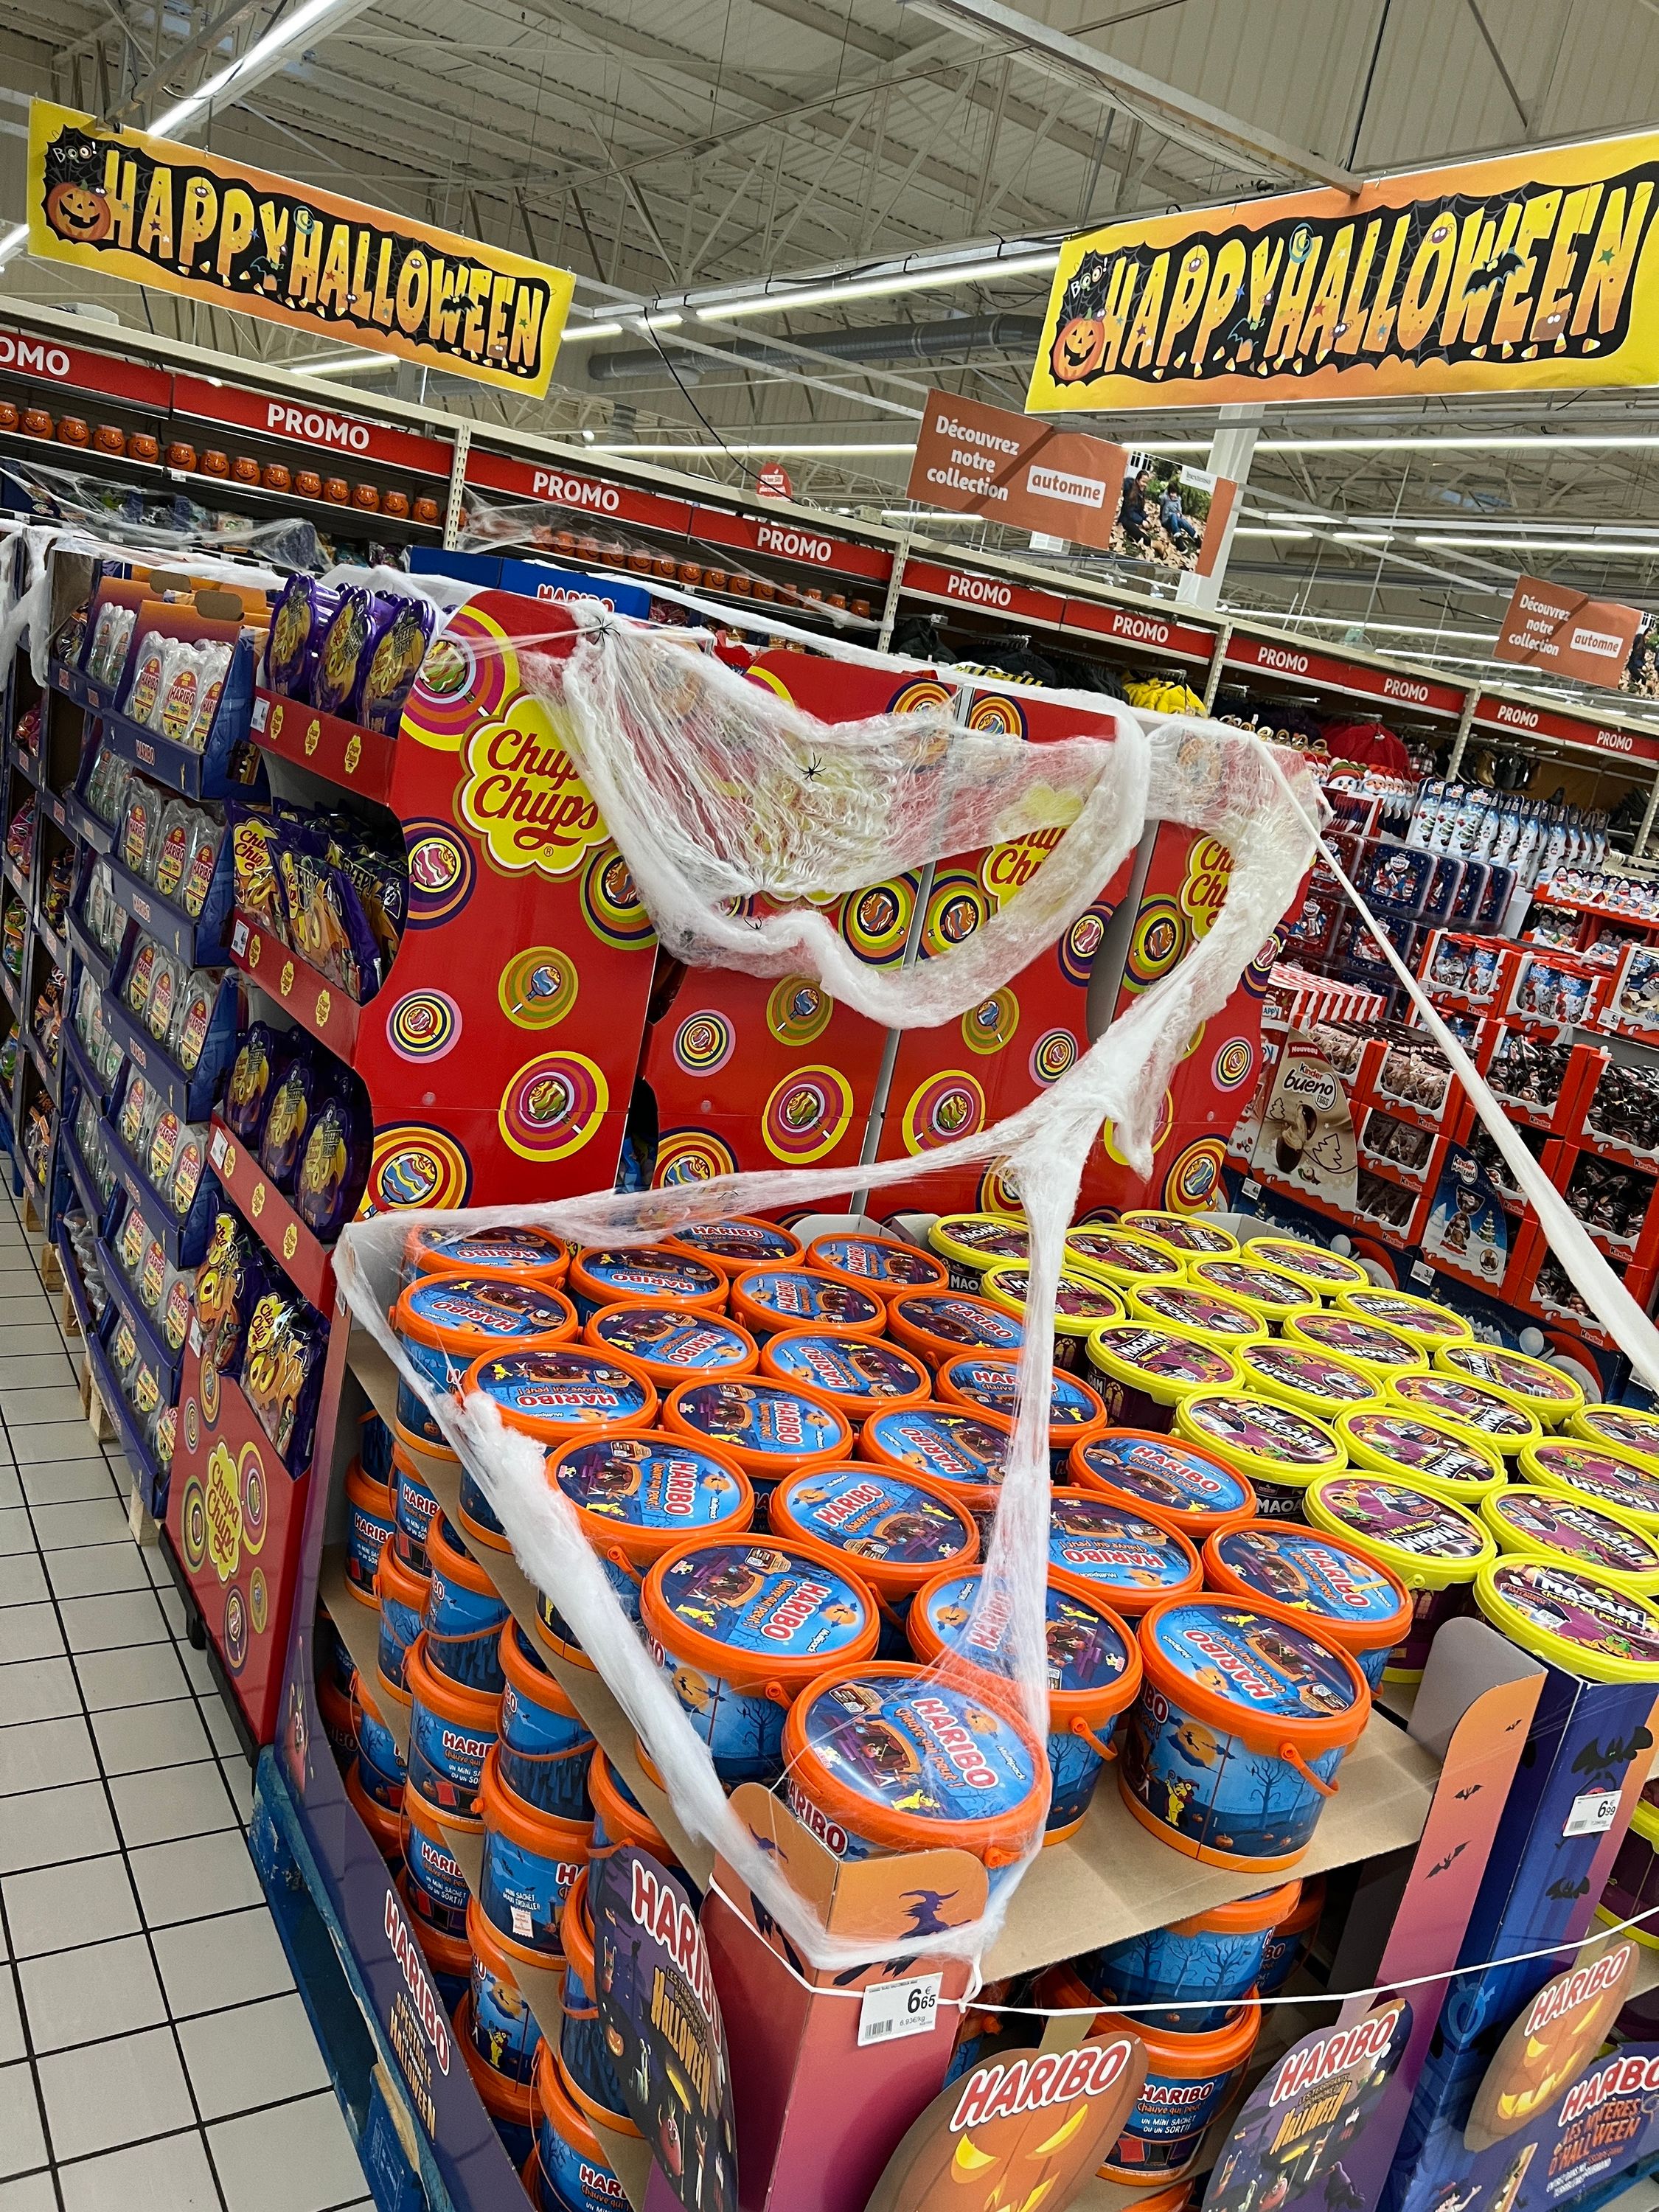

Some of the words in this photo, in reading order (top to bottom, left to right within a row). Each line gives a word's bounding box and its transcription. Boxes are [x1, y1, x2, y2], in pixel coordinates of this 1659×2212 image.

[54, 141, 99, 164] BOO!
[105, 149, 289, 291] HAPPY
[288, 207, 543, 367] HALLOWEEN
[1070, 257, 1109, 299] BOO!
[1098, 234, 1284, 374] HAPPY
[1264, 181, 1656, 361] HALLOWEEN
[0, 337, 70, 376] OMO
[267, 403, 369, 450] PROMO
[936, 415, 1020, 456] Découvrez
[950, 448, 995, 474] notre
[532, 472, 619, 512] PROMO
[927, 467, 1009, 501] collection
[1032, 473, 1102, 501] automne
[757, 528, 832, 563] PROMO
[947, 574, 1012, 607] PROMO
[1520, 594, 1571, 622] Découvrez
[1113, 614, 1169, 644] PROMO
[1526, 618, 1554, 635] notre
[1509, 632, 1559, 656] collection
[1575, 633, 1619, 653] automne
[1257, 646, 1309, 673] PROMO
[169, 686, 195, 706] HARIBO
[1384, 678, 1428, 703] PROMO
[1497, 704, 1539, 728] PROMO
[136, 740, 155, 765] HARIBO
[1596, 730, 1633, 751] PROMO
[473, 773, 599, 849] Chups
[165, 841, 185, 861] HARIBO
[195, 860, 213, 882] HARIBO
[1467, 1004, 1489, 1018] Kinder
[1291, 1046, 1318, 1055] Nouveau
[1284, 1068, 1334, 1096] bueno
[1300, 1062, 1324, 1080] Kinder
[1317, 1094, 1330, 1107] EGGS
[1418, 1117, 1439, 1132] Kinder
[1529, 1114, 1551, 1130] Kinder
[181, 1156, 199, 1180] HARIBO
[1400, 1177, 1422, 1192] Kinder
[692, 1226, 764, 1239] HARIBO
[955, 1222, 1007, 1243] MAOAM
[1382, 1232, 1404, 1248] Kinder
[457, 1248, 541, 1260] HARIBO
[847, 1245, 868, 1275] HARIBO
[1121, 1243, 1166, 1272] MAOAM
[1610, 1246, 1632, 1262] Kinder
[611, 1273, 695, 1292] HARIBO
[776, 1280, 799, 1312] HARIBO
[950, 1275, 980, 1291] MAO
[1253, 1273, 1303, 1301] MAOAM
[432, 1300, 519, 1332] HARIBO
[1365, 1299, 1412, 1313] MAOAM
[946, 1303, 1014, 1340] HARIBO
[667, 1331, 726, 1364] HARIBO
[1117, 1331, 1169, 1359] MAOAM
[1580, 1329, 1604, 1346] Kinder
[799, 1346, 850, 1388] HARIBO
[1254, 1362, 1332, 1397] MAOAM
[517, 1393, 619, 1407] HARIBO
[774, 1399, 803, 1444] HARIBO
[1249, 1408, 1323, 1450] MAOAM
[901, 1427, 967, 1473] HARIBO
[1132, 1446, 1222, 1493] HARIBO
[212, 1461, 240, 1528] Chupa
[403, 1484, 440, 1517] HARIB
[664, 1461, 698, 1516] HARIBO
[1572, 1476, 1656, 1511] MAOAM
[813, 1483, 886, 1528] HARIBO
[1256, 1498, 1304, 1513] MAOA
[207, 1489, 236, 1564] Chups
[1391, 1524, 1464, 1553] MAOAM
[1559, 1511, 1643, 1557] MAOAM
[1063, 1548, 1167, 1569] HARIBO
[1301, 1548, 1371, 1608] HARIBO
[760, 1581, 832, 1641] HARIBO
[1541, 1576, 1640, 1624] MAOAM
[806, 1627, 831, 1653] Multipack
[1183, 1630, 1277, 1700] HARIBO
[442, 1730, 493, 1759] HARI
[445, 1748, 469, 1764] Chauve
[893, 1707, 926, 1738] Chauve
[921, 1734, 938, 1755] qui
[933, 1752, 959, 1783] peut
[911, 1697, 999, 1790] HARIBO
[996, 1745, 1026, 1781] Multipack
[789, 1779, 849, 1856] ARIBO
[422, 1841, 465, 1878] HARIB
[632, 1858, 723, 2054] HARIBO
[385, 1888, 450, 2077] HARIBO
[1524, 1947, 1631, 2037] HARIBO
[651, 1966, 711, 2118] HALLOWEEN
[389, 2006, 437, 2141] HALLOWEEN
[1269, 2009, 1400, 2108] HARIBO
[950, 2039, 1133, 2132] HARIBO
[1137, 2081, 1215, 2105] HARIBO
[1137, 2102, 1169, 2115] Chauve
[1171, 2115, 1197, 2126] SACHET
[1270, 2080, 1353, 2155] HALLOWEEN
